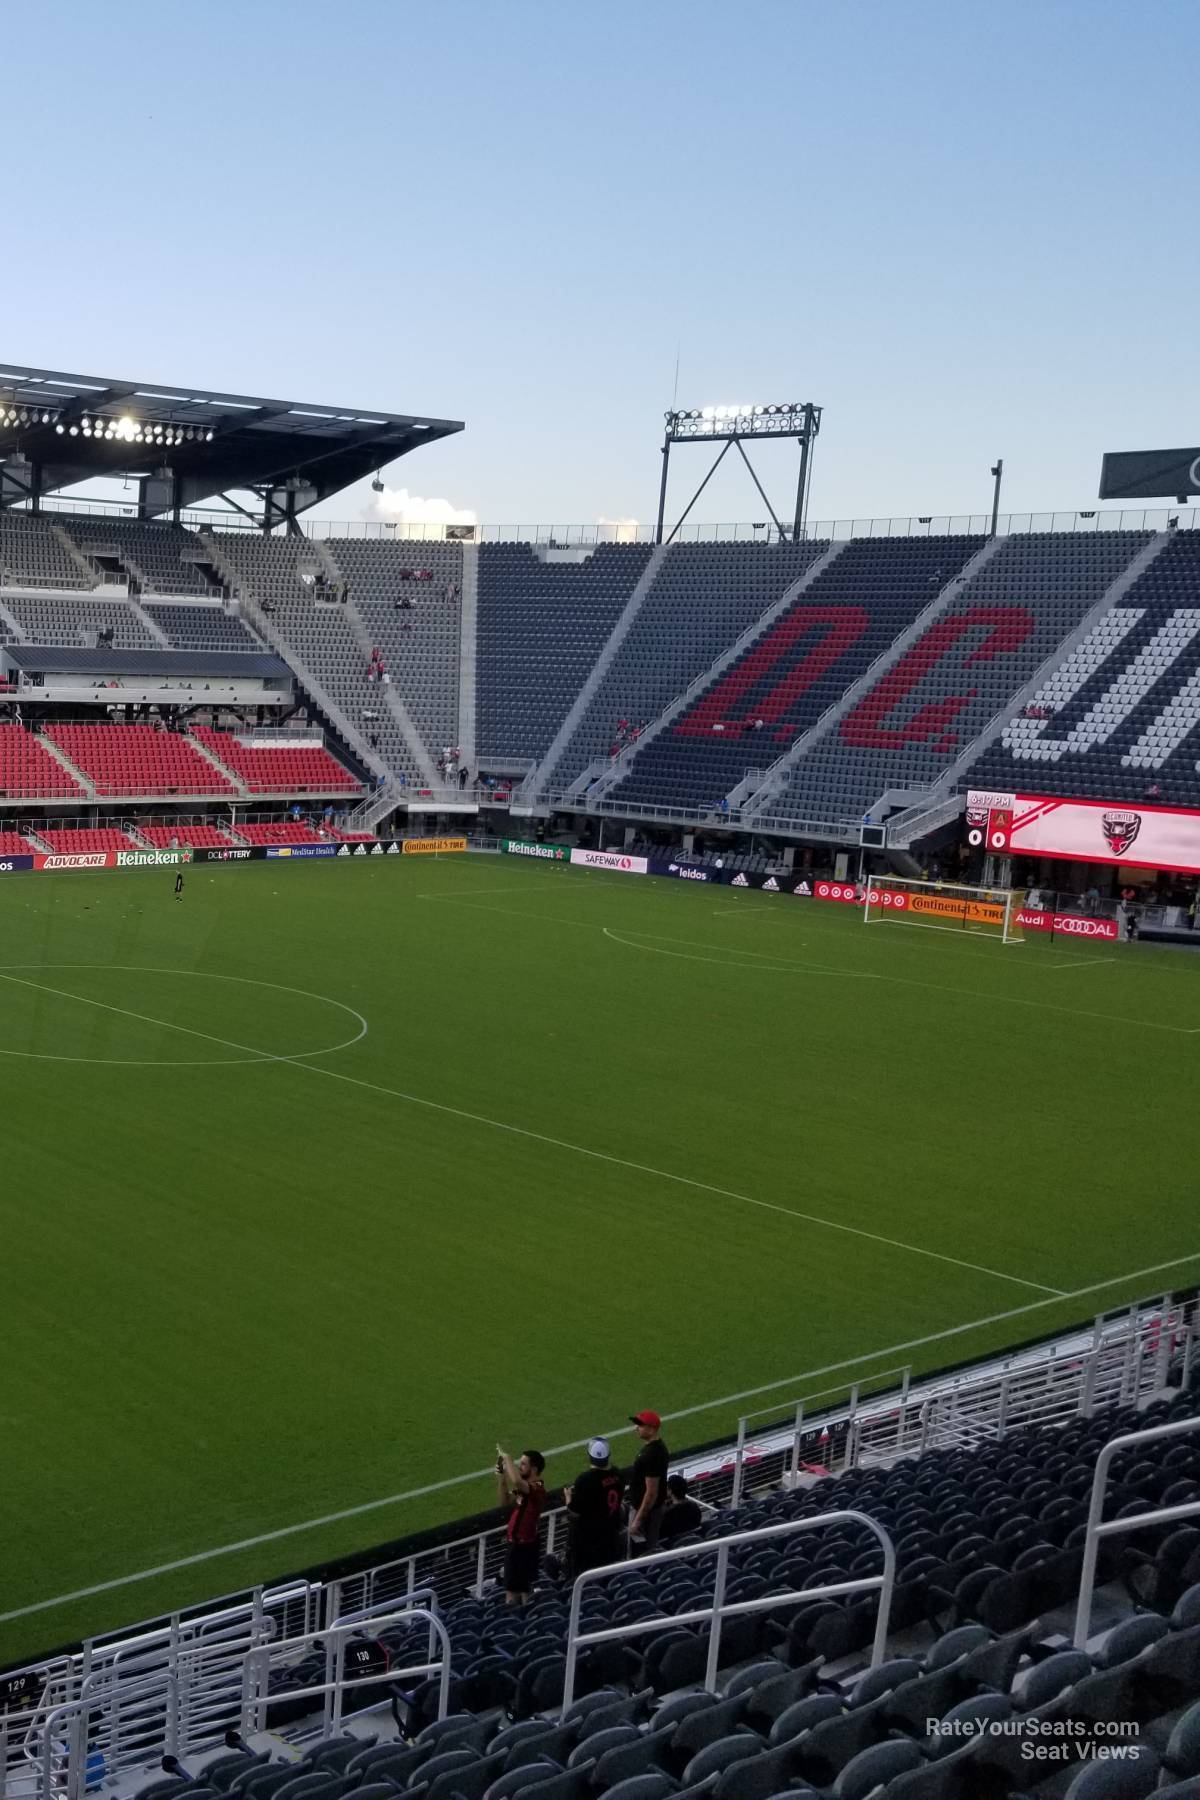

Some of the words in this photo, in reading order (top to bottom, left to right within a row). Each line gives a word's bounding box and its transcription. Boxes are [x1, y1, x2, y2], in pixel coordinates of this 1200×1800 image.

[994, 797, 1010, 806] PM
[968, 829, 982, 845] 0
[991, 831, 1006, 848] 0
[449, 840, 465, 850] TIRE
[508, 841, 554, 858] Heineken
[44, 854, 106, 869] ADVOCARE
[116, 851, 178, 866] Heineken
[585, 854, 621, 868] SAFEWAY
[679, 867, 707, 881] leidos
[912, 897, 970, 914] Continental
[1016, 914, 1044, 925] Audi
[357, 1650, 370, 1661] 130
[8, 1678, 26, 1692] 129
